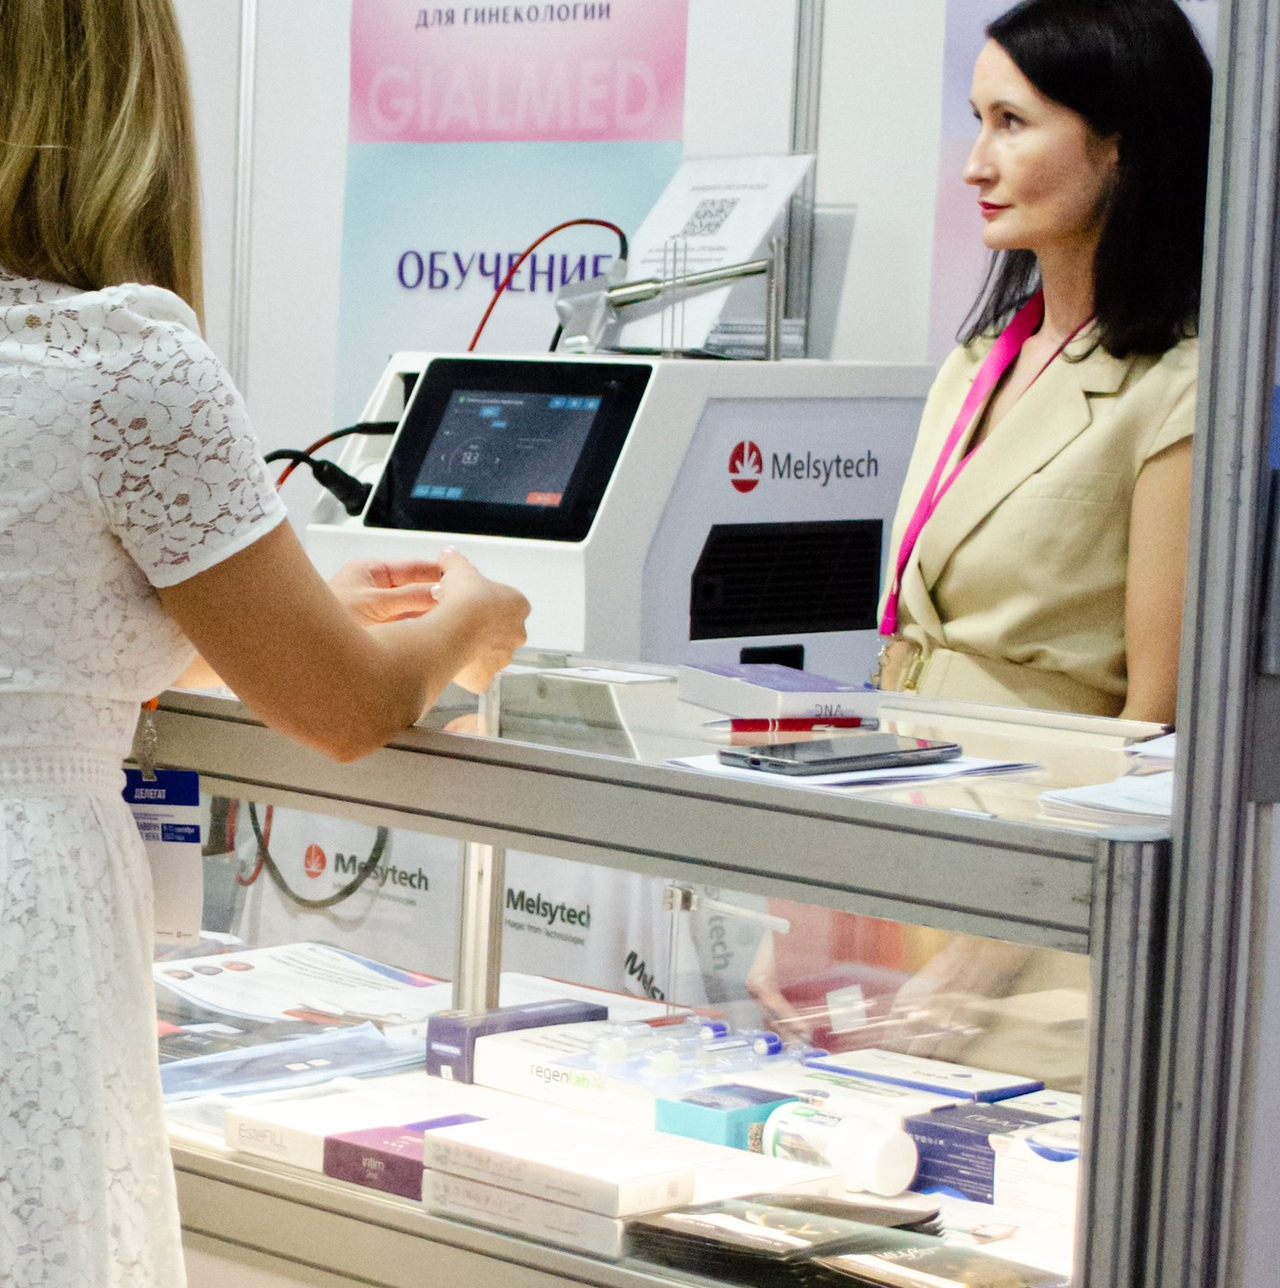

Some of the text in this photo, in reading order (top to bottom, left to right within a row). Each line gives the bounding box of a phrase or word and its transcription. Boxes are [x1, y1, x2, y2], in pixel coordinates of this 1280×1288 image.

[415, 2, 612, 30] ДЛЯ ГИНЕКОЛОГИИ
[368, 59, 661, 135] GIALMED
[771, 449, 880, 488] Melsytech
[134, 787, 167, 800] ДЕЛЕГАТ
[238, 1122, 289, 1150] EsteFILL
[361, 1155, 385, 1173] intim
